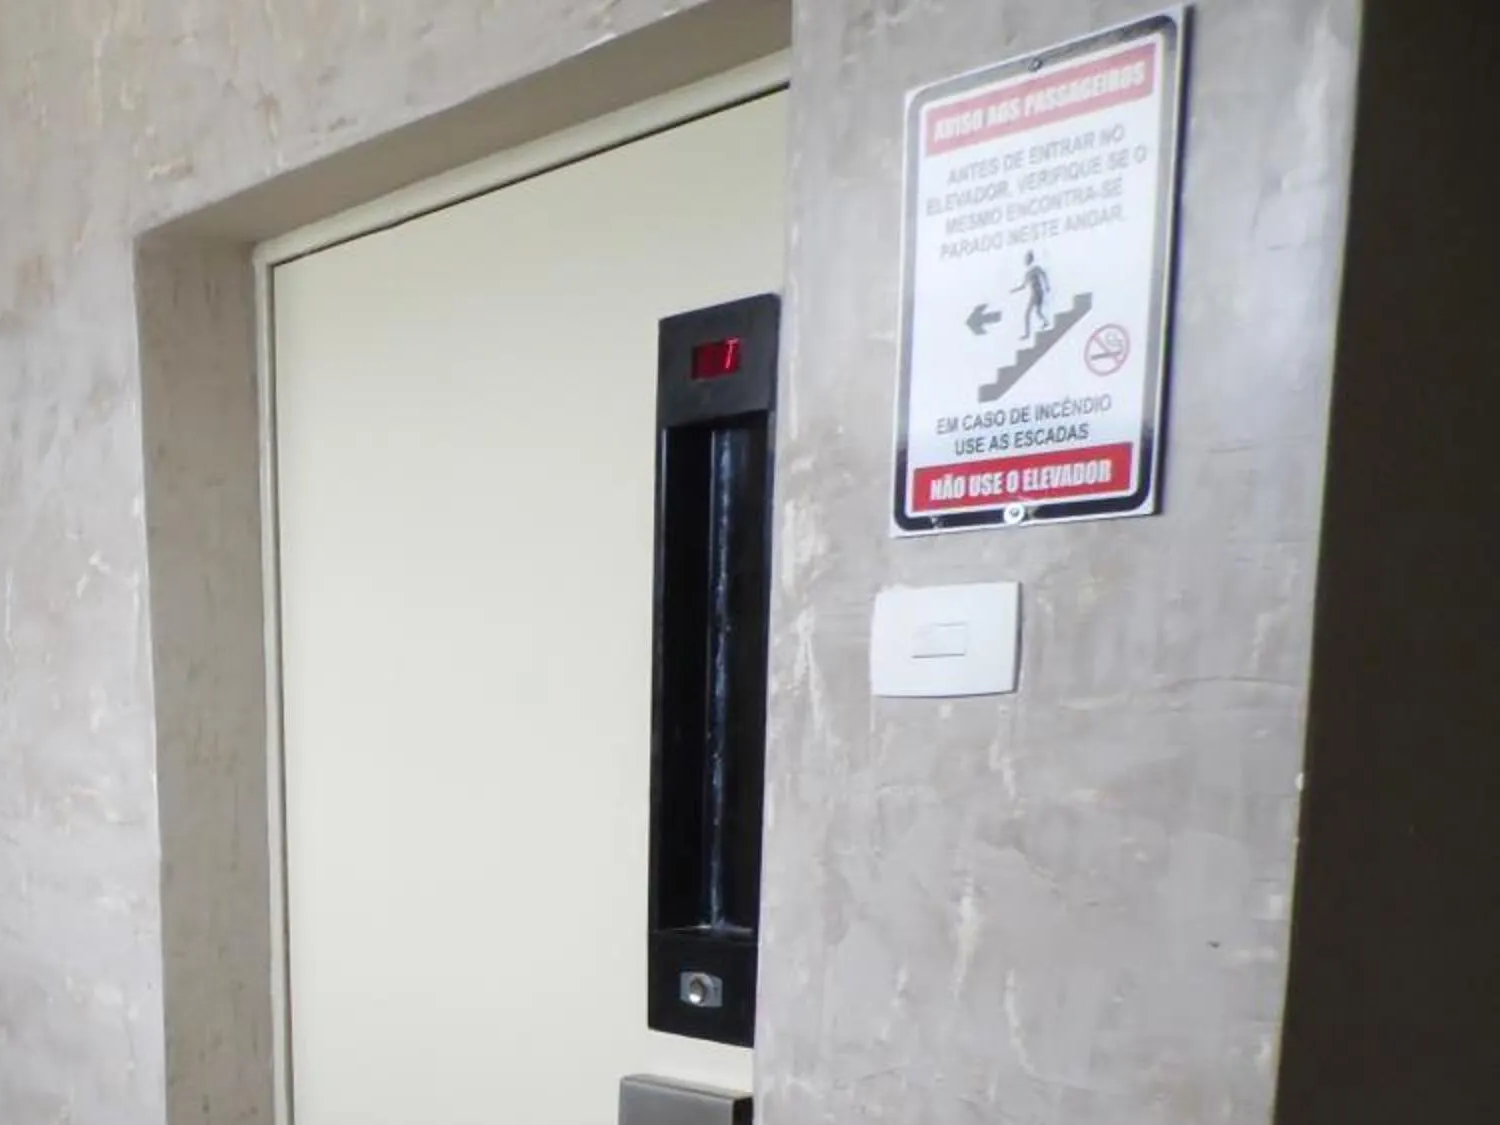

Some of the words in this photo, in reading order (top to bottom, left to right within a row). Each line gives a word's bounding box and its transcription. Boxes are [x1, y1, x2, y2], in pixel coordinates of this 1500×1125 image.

[1025, 61, 1146, 116] PASSAGEIROS
[947, 157, 1000, 185] ANTES
[1003, 149, 1023, 170] DE
[1029, 131, 1094, 165] ENTRAR
[1099, 123, 1125, 146] NO
[1017, 155, 1102, 194] VERIFIQUE
[1106, 148, 1129, 171] SE
[1133, 144, 1147, 164] O
[940, 231, 1002, 260] PARADO
[1007, 219, 1059, 247] NESTE
[945, 206, 1002, 235] MESMO
[936, 416, 958, 435] EM
[962, 409, 1006, 431] CASO
[1009, 405, 1030, 425] DE
[1035, 393, 1112, 421] INCÊNDIO
[955, 437, 984, 456] USE
[988, 433, 1009, 452] AS
[1014, 423, 1089, 448] ESCADAS
[930, 473, 966, 501] NÃO
[969, 472, 1003, 497] USE
[1006, 469, 1019, 493] O
[1023, 458, 1112, 492] ELEVADOR
